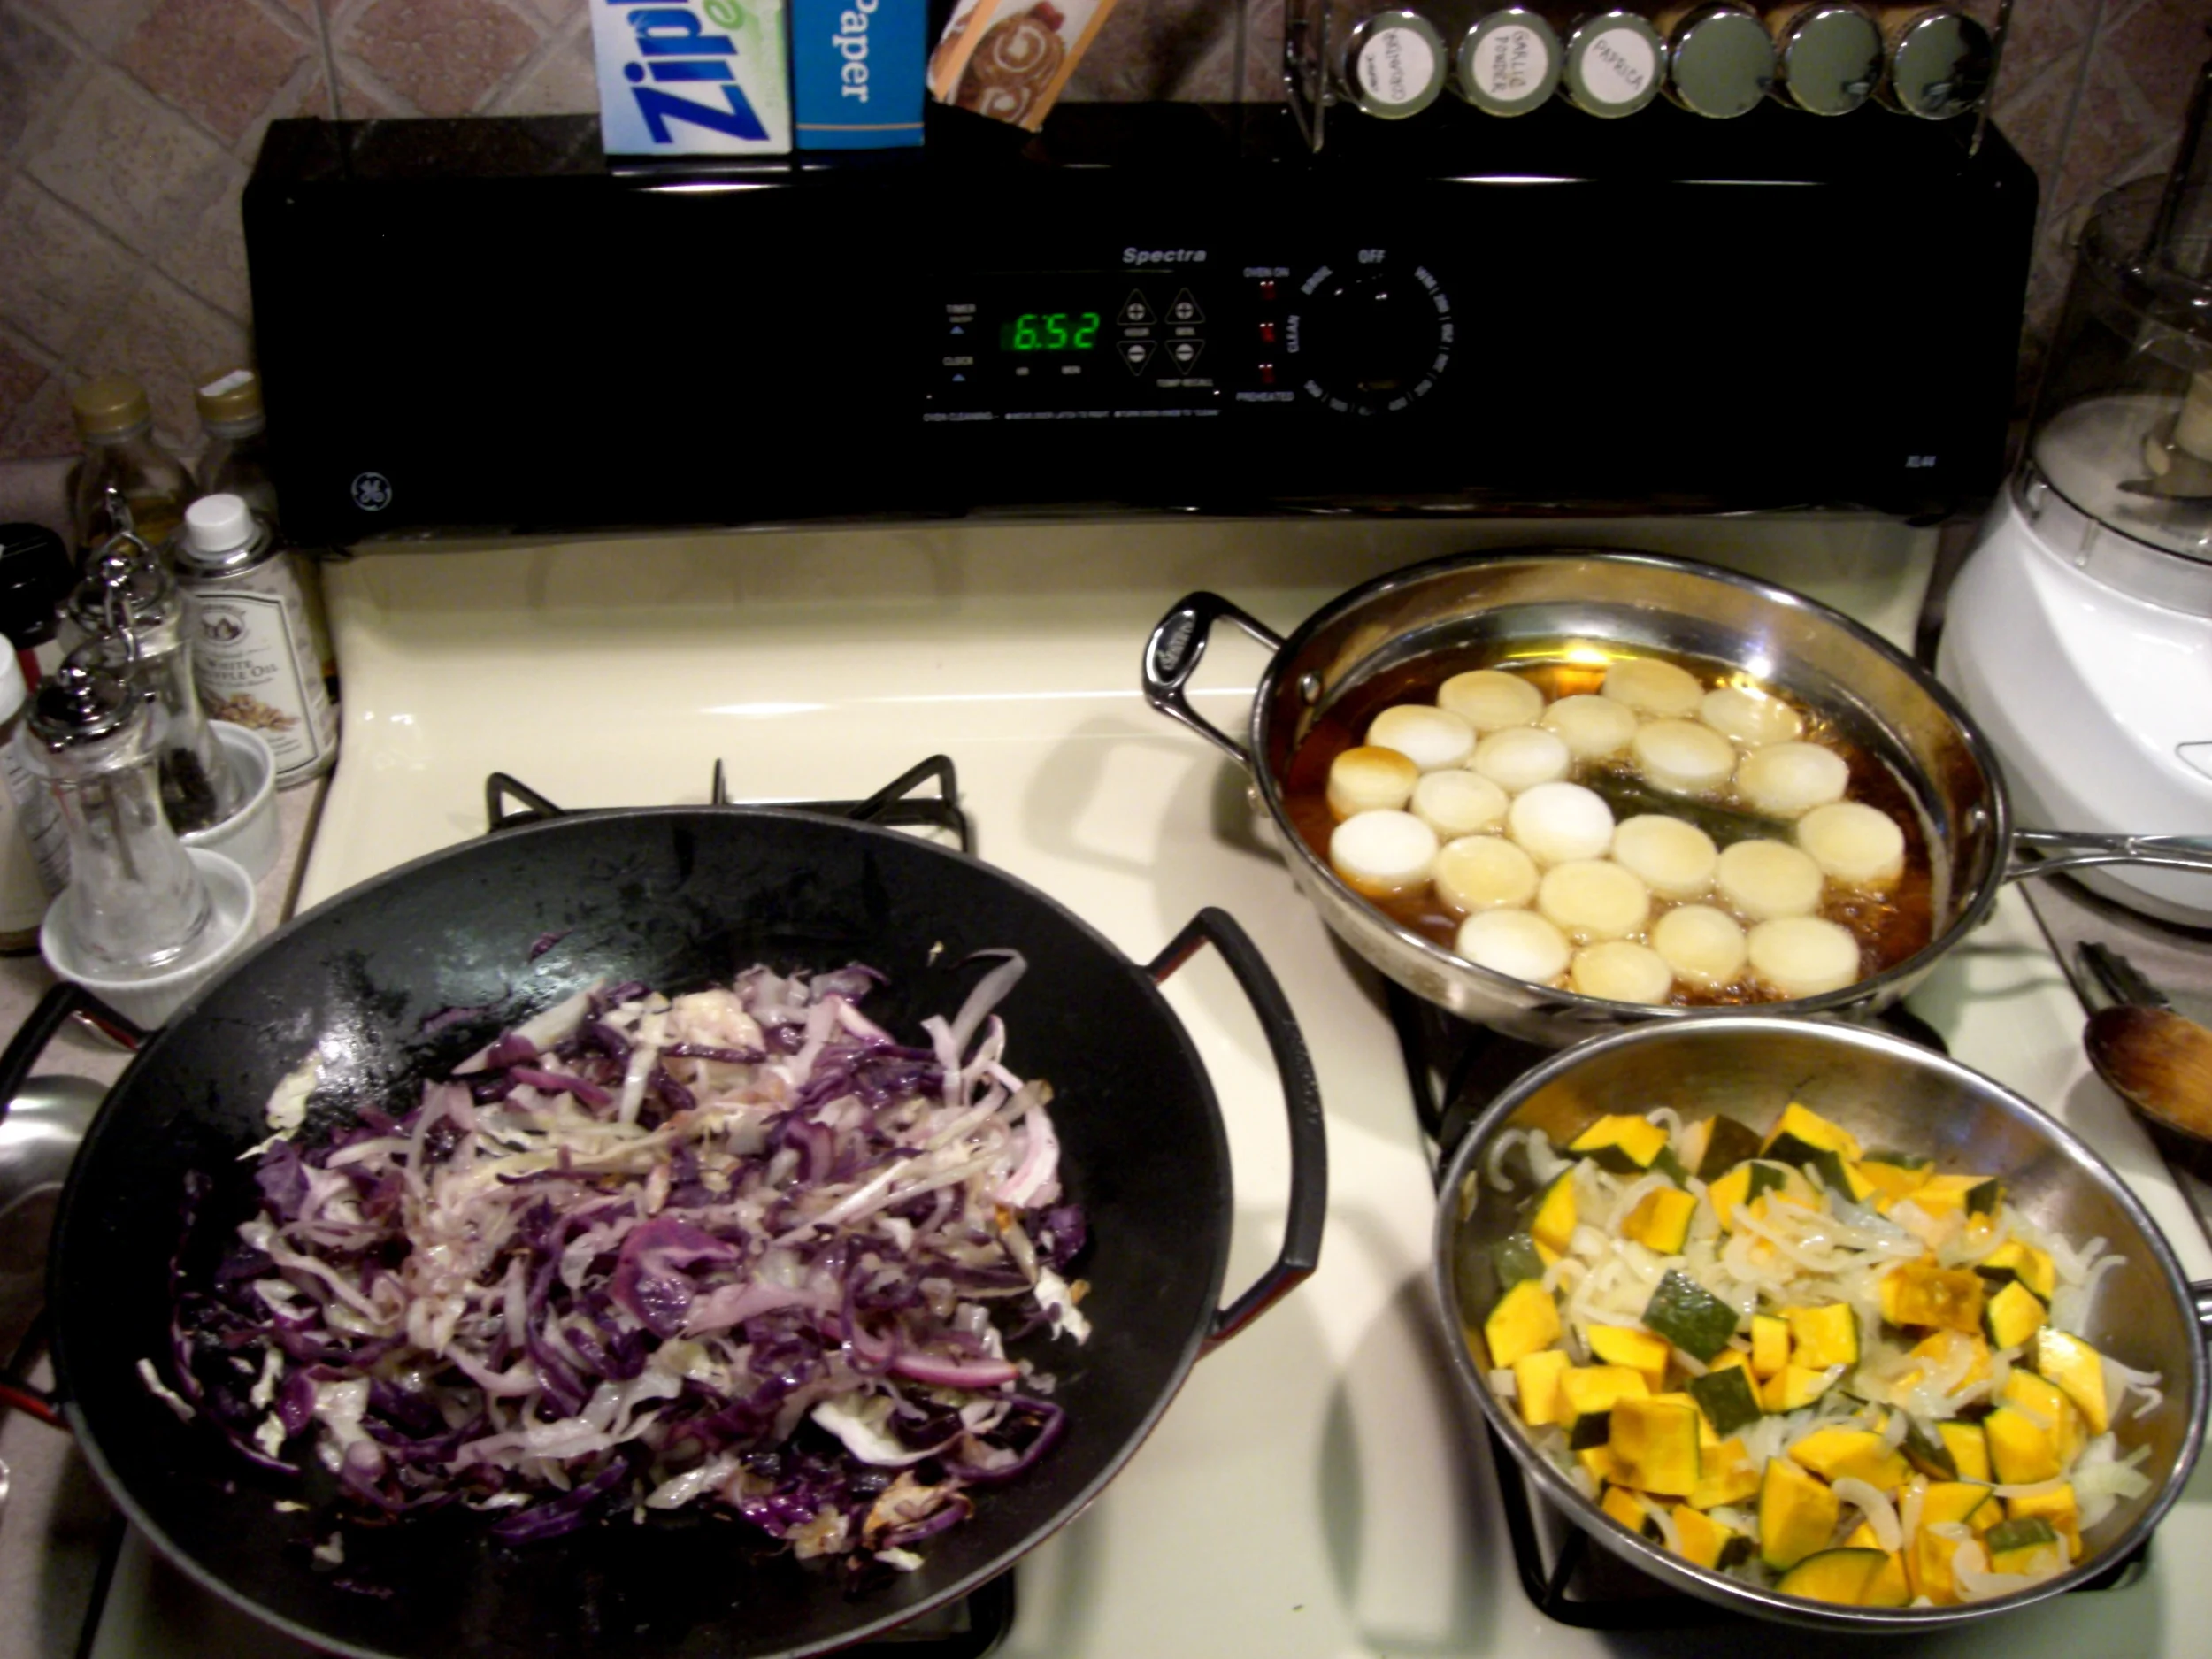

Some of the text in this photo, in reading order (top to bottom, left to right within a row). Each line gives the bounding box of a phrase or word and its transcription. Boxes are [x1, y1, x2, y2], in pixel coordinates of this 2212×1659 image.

[606, 0, 770, 143] Zip
[1490, 35, 1509, 94] POWDER
[1510, 30, 1530, 89] GARLIC
[1122, 246, 1207, 265] Spectra
[1358, 249, 1386, 264] OFF
[1285, 315, 1301, 353] CLEAN
